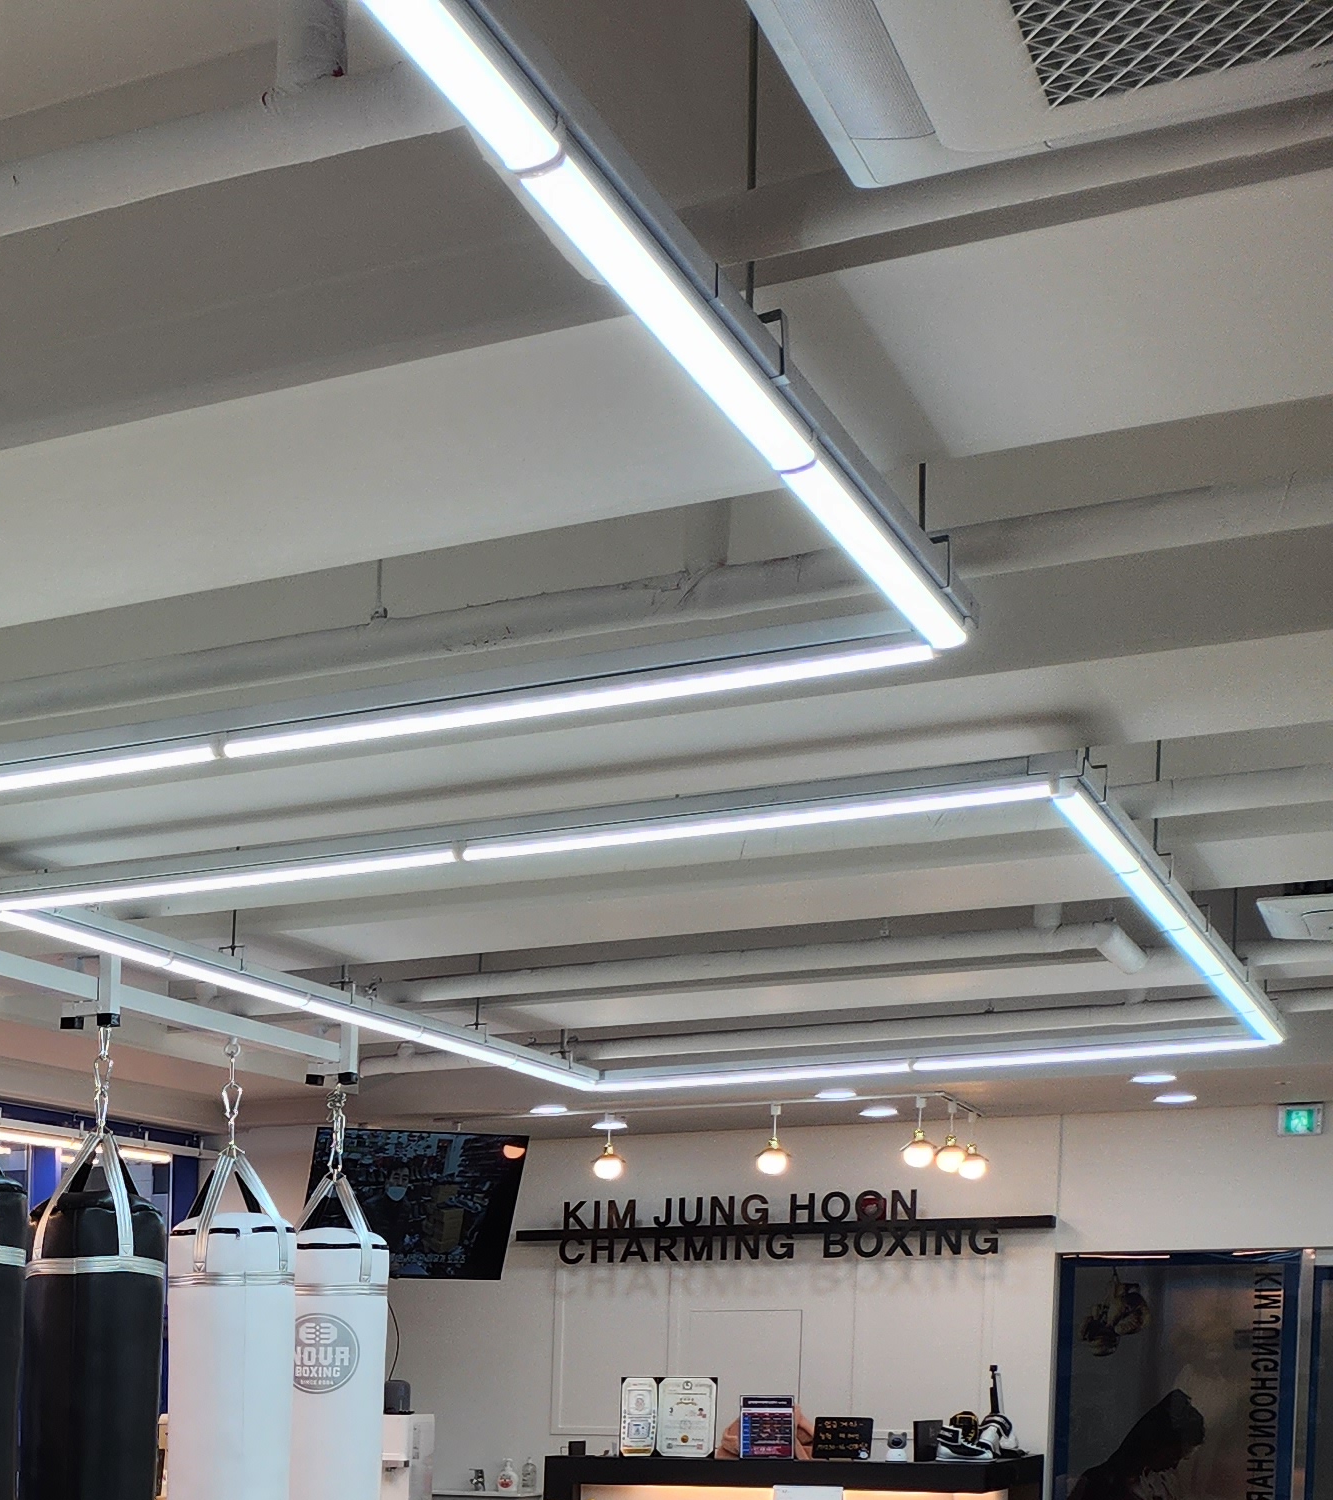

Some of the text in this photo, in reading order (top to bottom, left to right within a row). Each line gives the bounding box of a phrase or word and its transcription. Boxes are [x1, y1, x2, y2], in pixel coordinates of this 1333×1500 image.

[562, 1189, 918, 1231] KIM JUNG HOON
[559, 1222, 1000, 1265] CHARMING BOXING
[295, 1366, 341, 1377] BOXING
